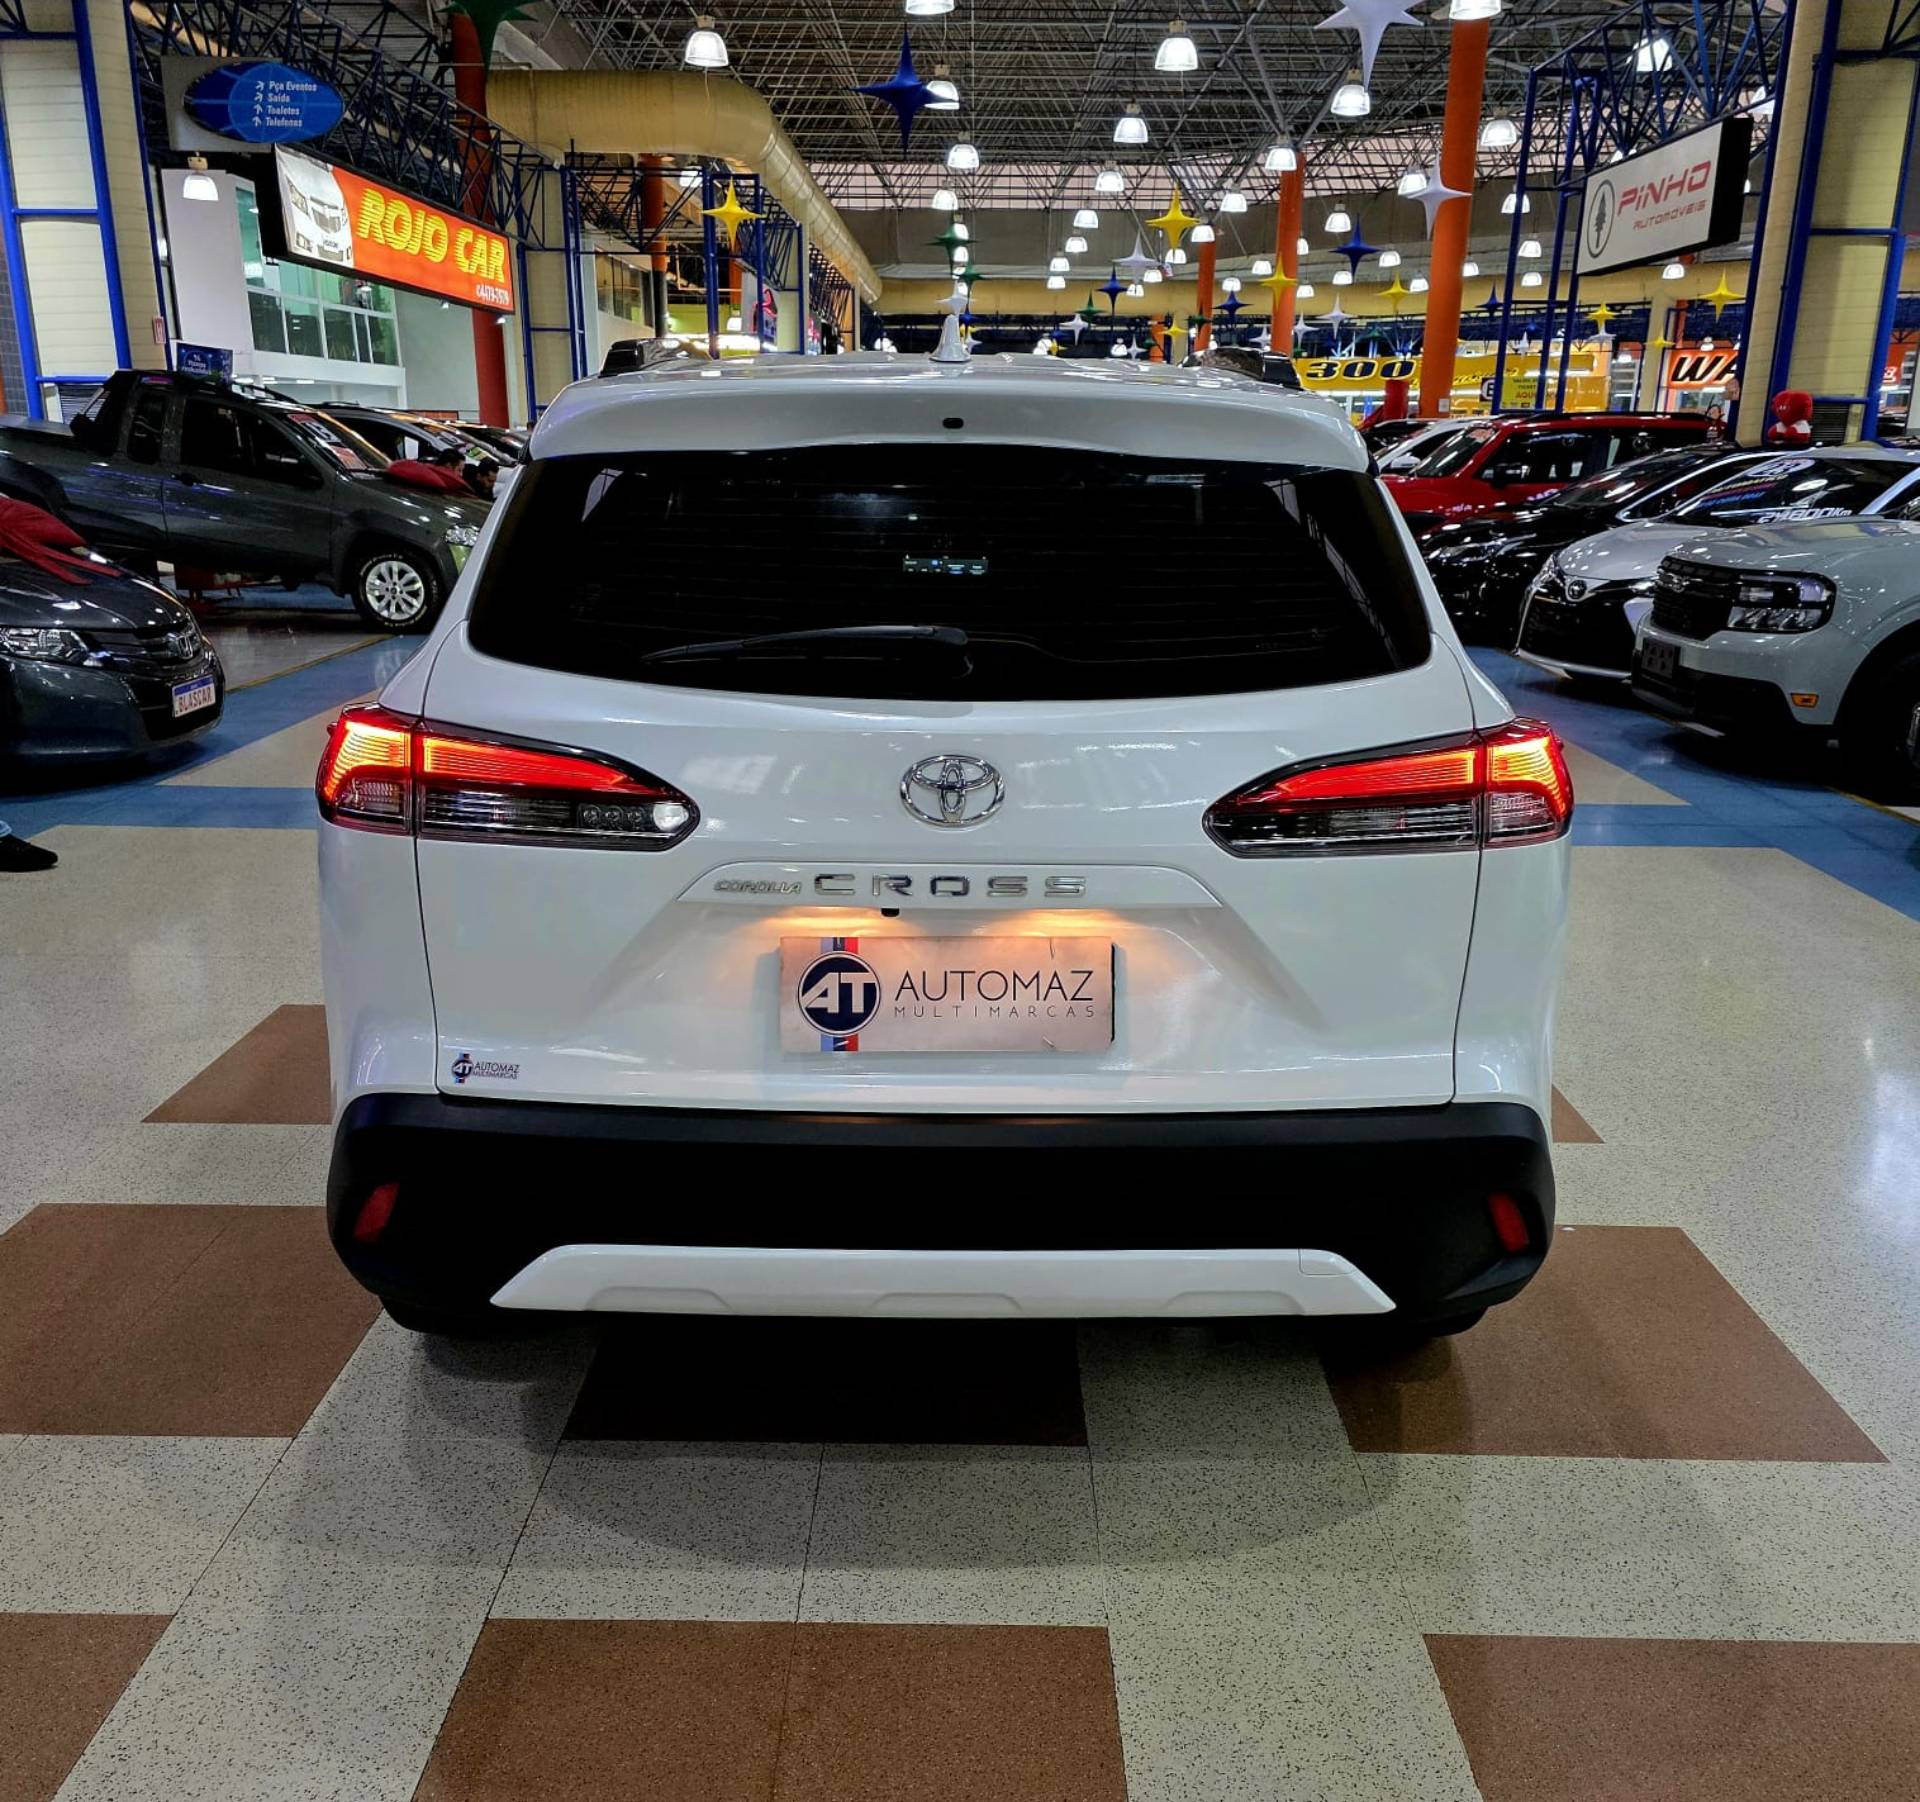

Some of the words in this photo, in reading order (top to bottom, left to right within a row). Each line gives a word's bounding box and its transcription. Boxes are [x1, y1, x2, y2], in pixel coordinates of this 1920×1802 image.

[286, 81, 317, 92] Eventos
[267, 105, 300, 115] Toaletes
[265, 117, 303, 127] Telefones
[1617, 159, 1712, 217] PINHO
[356, 188, 449, 263] ROJO
[454, 227, 505, 283] CAR
[1306, 360, 1417, 381] 300
[178, 686, 212, 713] BLASCAR
[713, 880, 802, 896] COROLLA
[814, 873, 1087, 898] CROSS
[802, 972, 876, 1014] AT
[894, 969, 1096, 1003] AUTOMAZ
[893, 1004, 1096, 1019] MULTIMARCAS
[474, 1061, 520, 1074] AUTOMAZ
